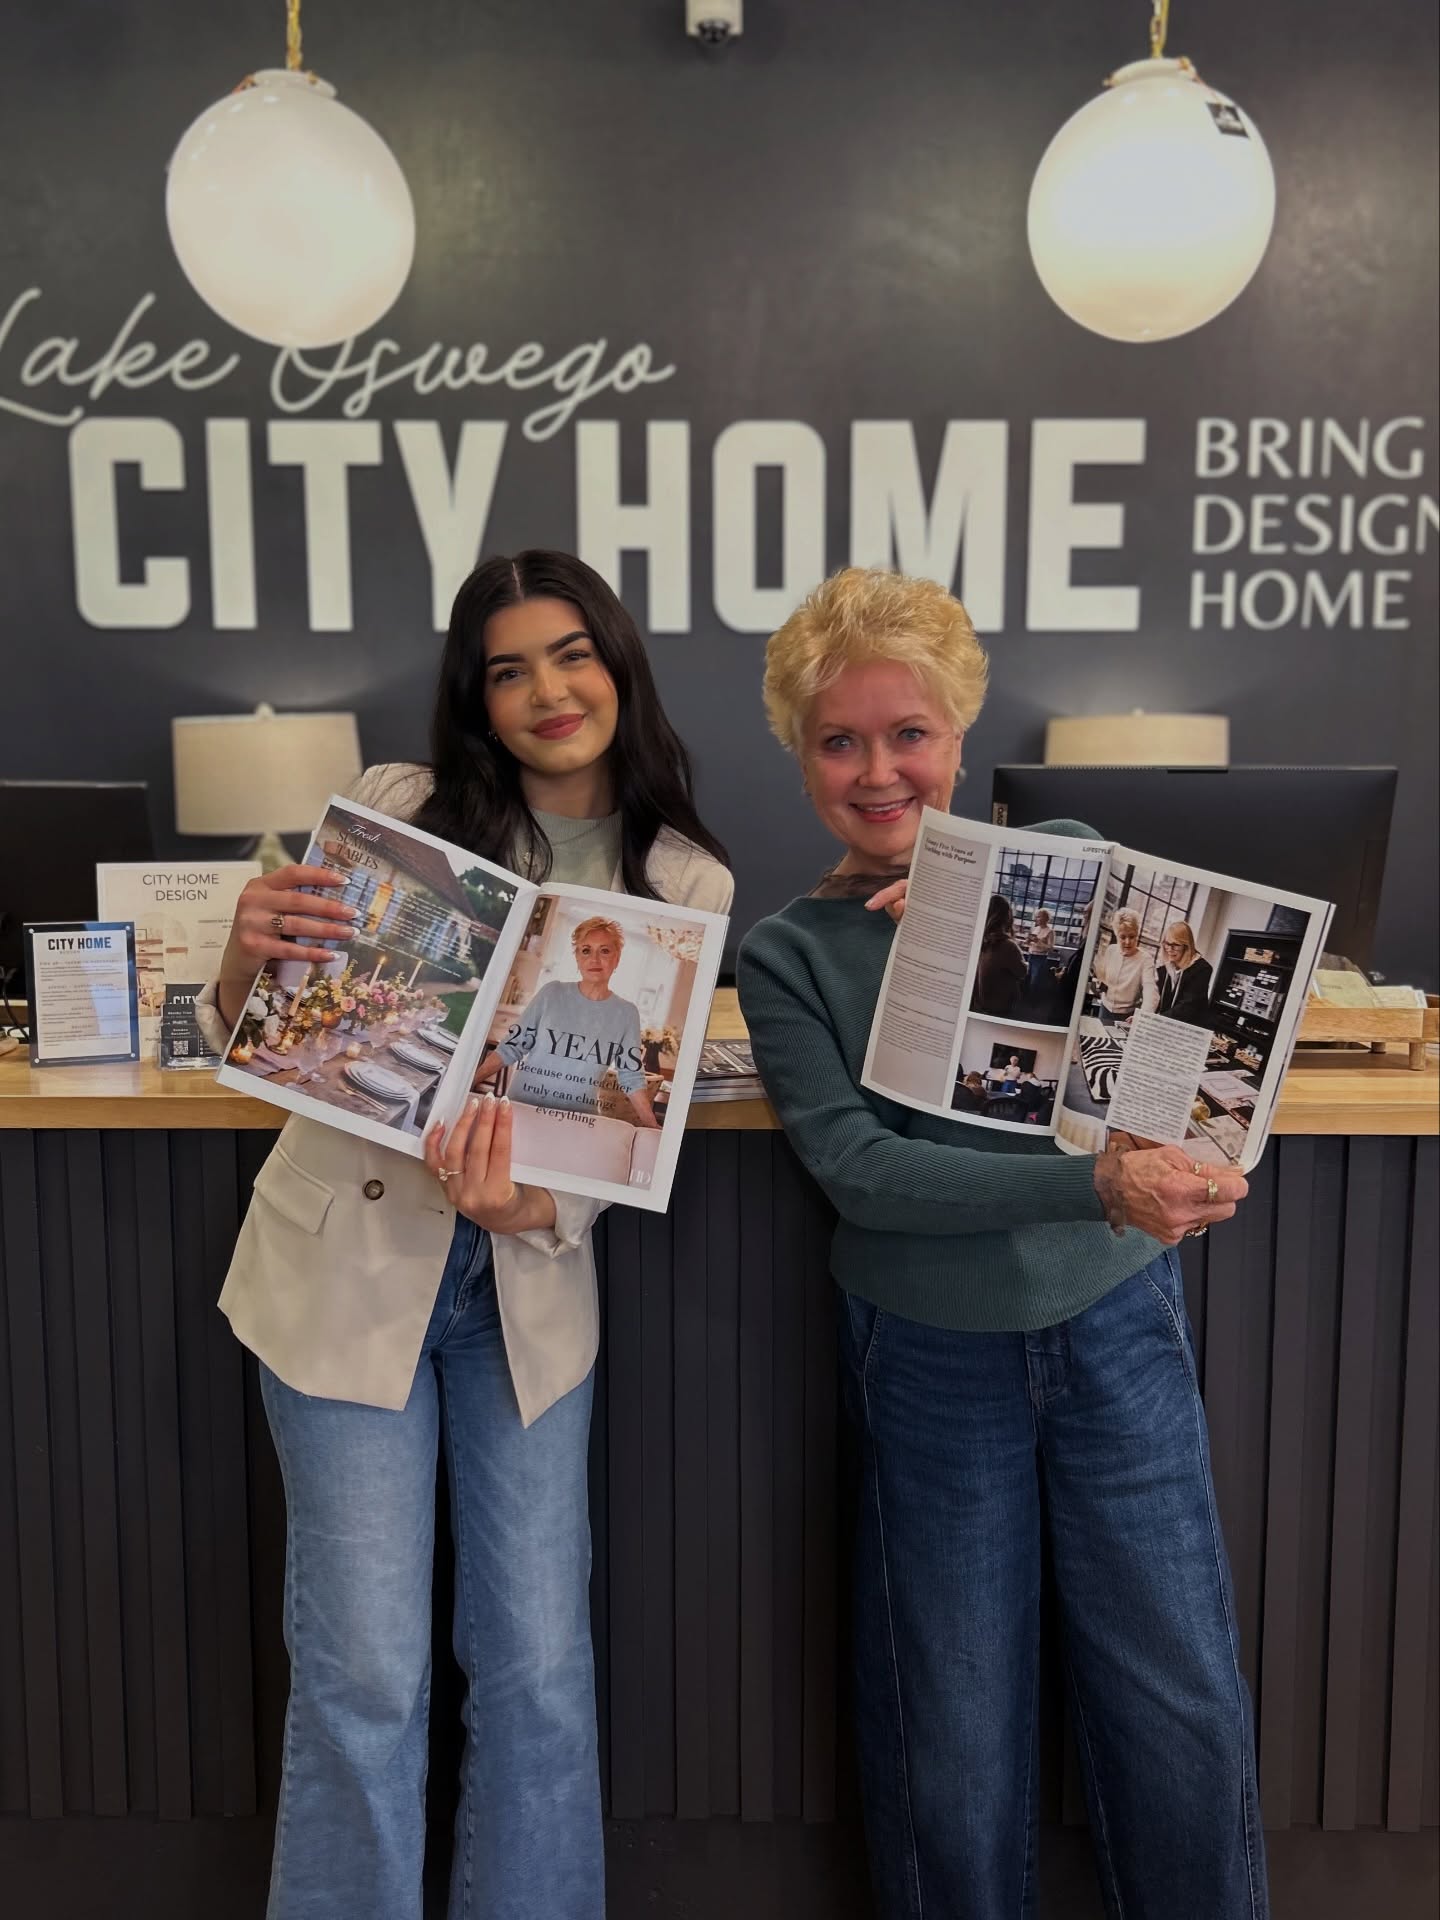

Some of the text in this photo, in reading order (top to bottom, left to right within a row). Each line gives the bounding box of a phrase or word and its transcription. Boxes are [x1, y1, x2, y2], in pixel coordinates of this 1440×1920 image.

[270, 336, 676, 441] Oswego
[1195, 416, 1424, 479] BRING
[68, 417, 1146, 633] CITY HOME
[1190, 570, 1411, 630] HOME
[347, 824, 382, 843] Fresh
[337, 843, 378, 870] TABLES
[142, 873, 219, 885] CITY HOME
[155, 889, 207, 901] DESIGN
[48, 937, 112, 950] CITY HOME
[505, 1024, 644, 1072] 25 YEARS
[516, 1060, 632, 1094] Because one teacher
[523, 1082, 617, 1111] truly can change
[536, 1107, 596, 1128] everything
